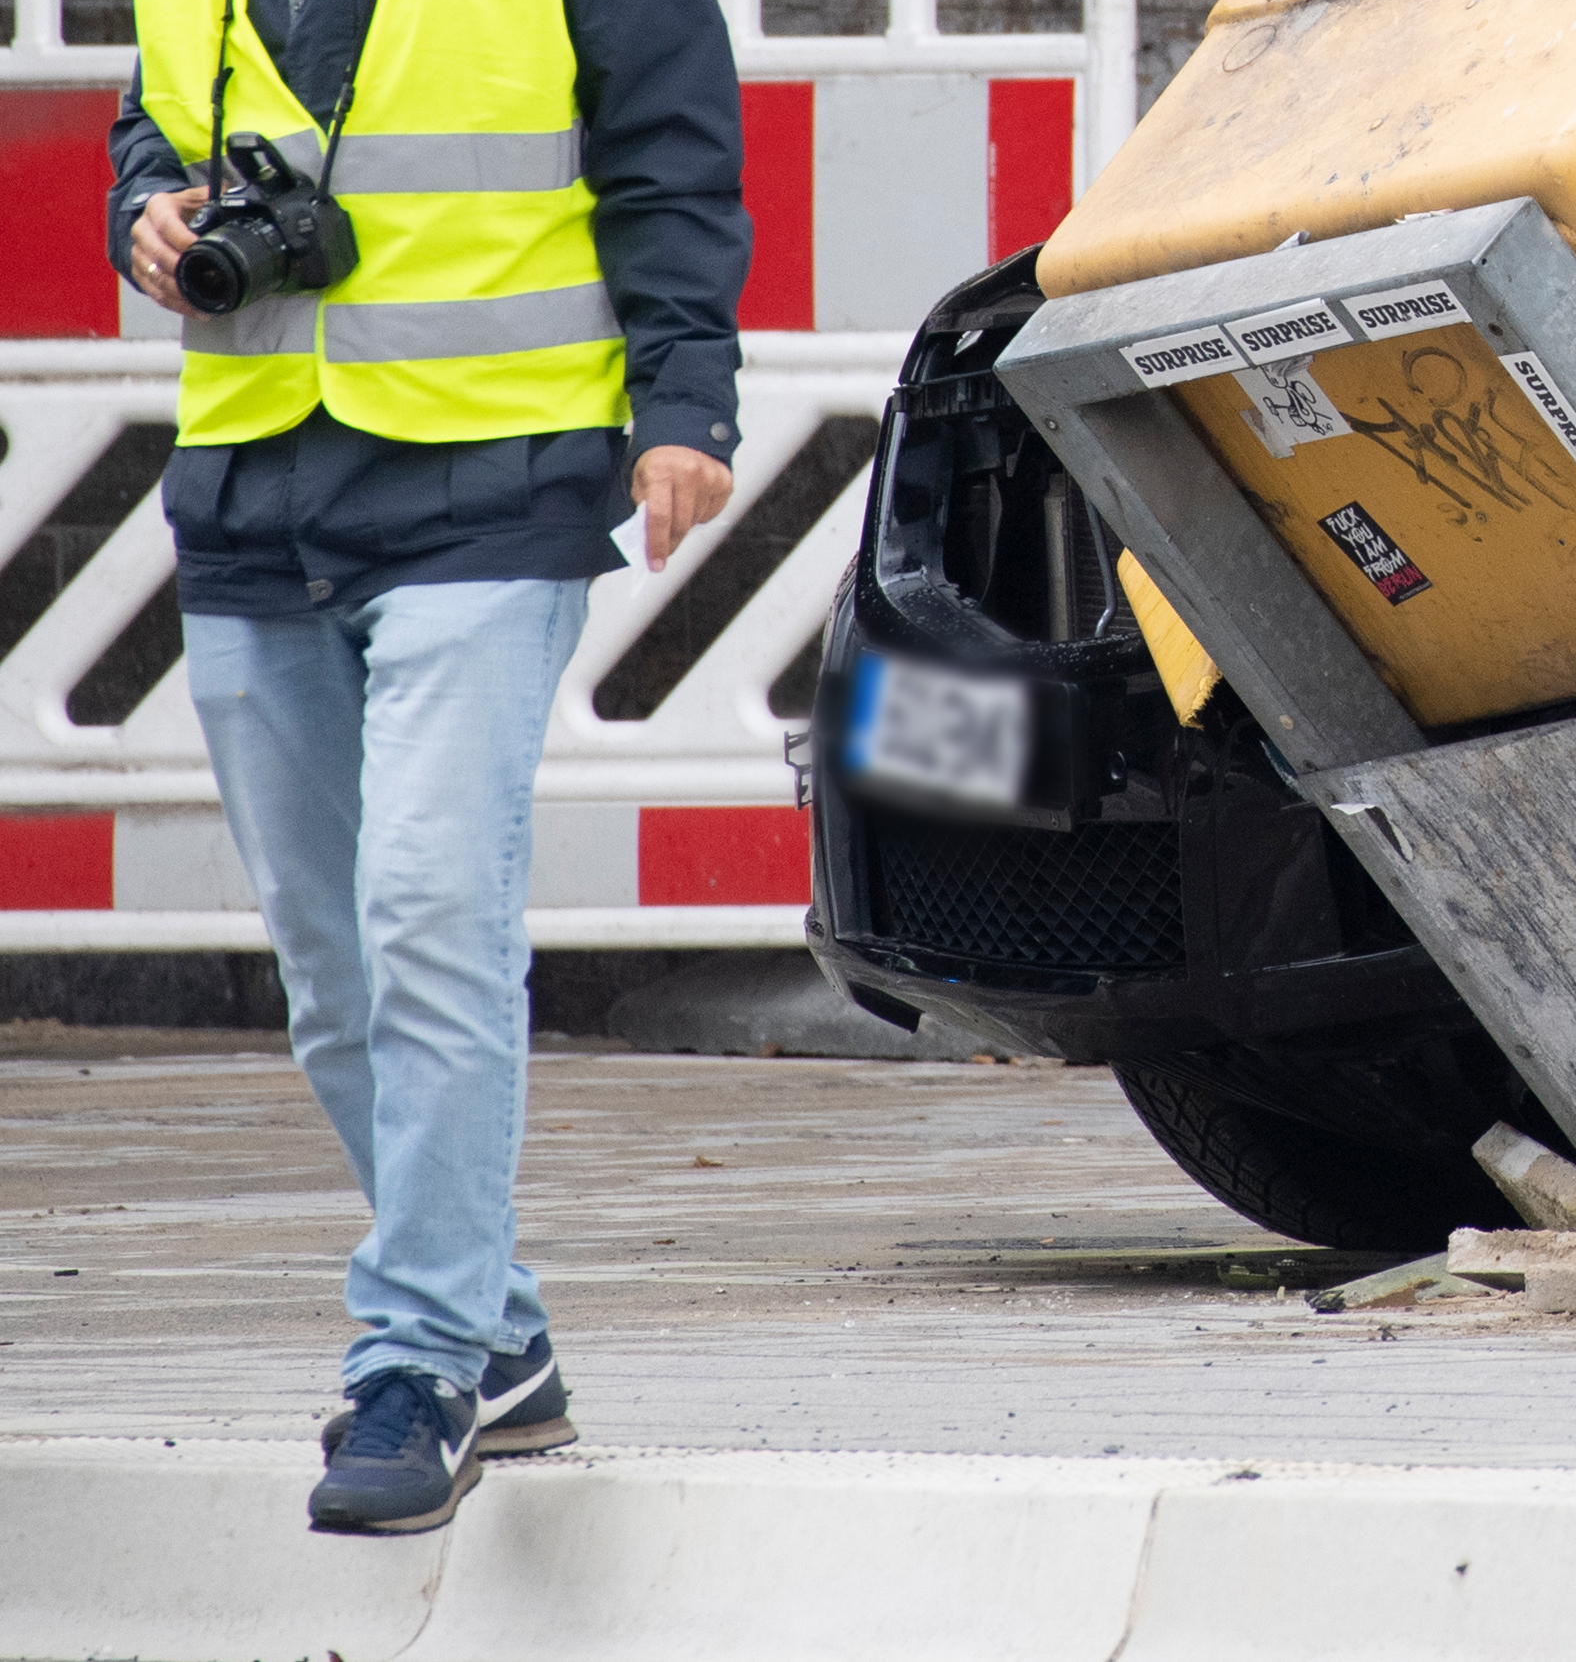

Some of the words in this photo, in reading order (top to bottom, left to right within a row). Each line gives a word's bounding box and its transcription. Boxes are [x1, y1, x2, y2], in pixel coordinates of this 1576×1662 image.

[1357, 292, 1457, 329] SURPRISE
[1241, 311, 1337, 352] SURPRISE
[1135, 337, 1232, 376] SURPRISE
[1325, 506, 1362, 535] FUCK
[1340, 522, 1374, 548] YOU
[1355, 549, 1367, 564] I
[1364, 535, 1389, 561] AM
[1363, 548, 1407, 583] FROM
